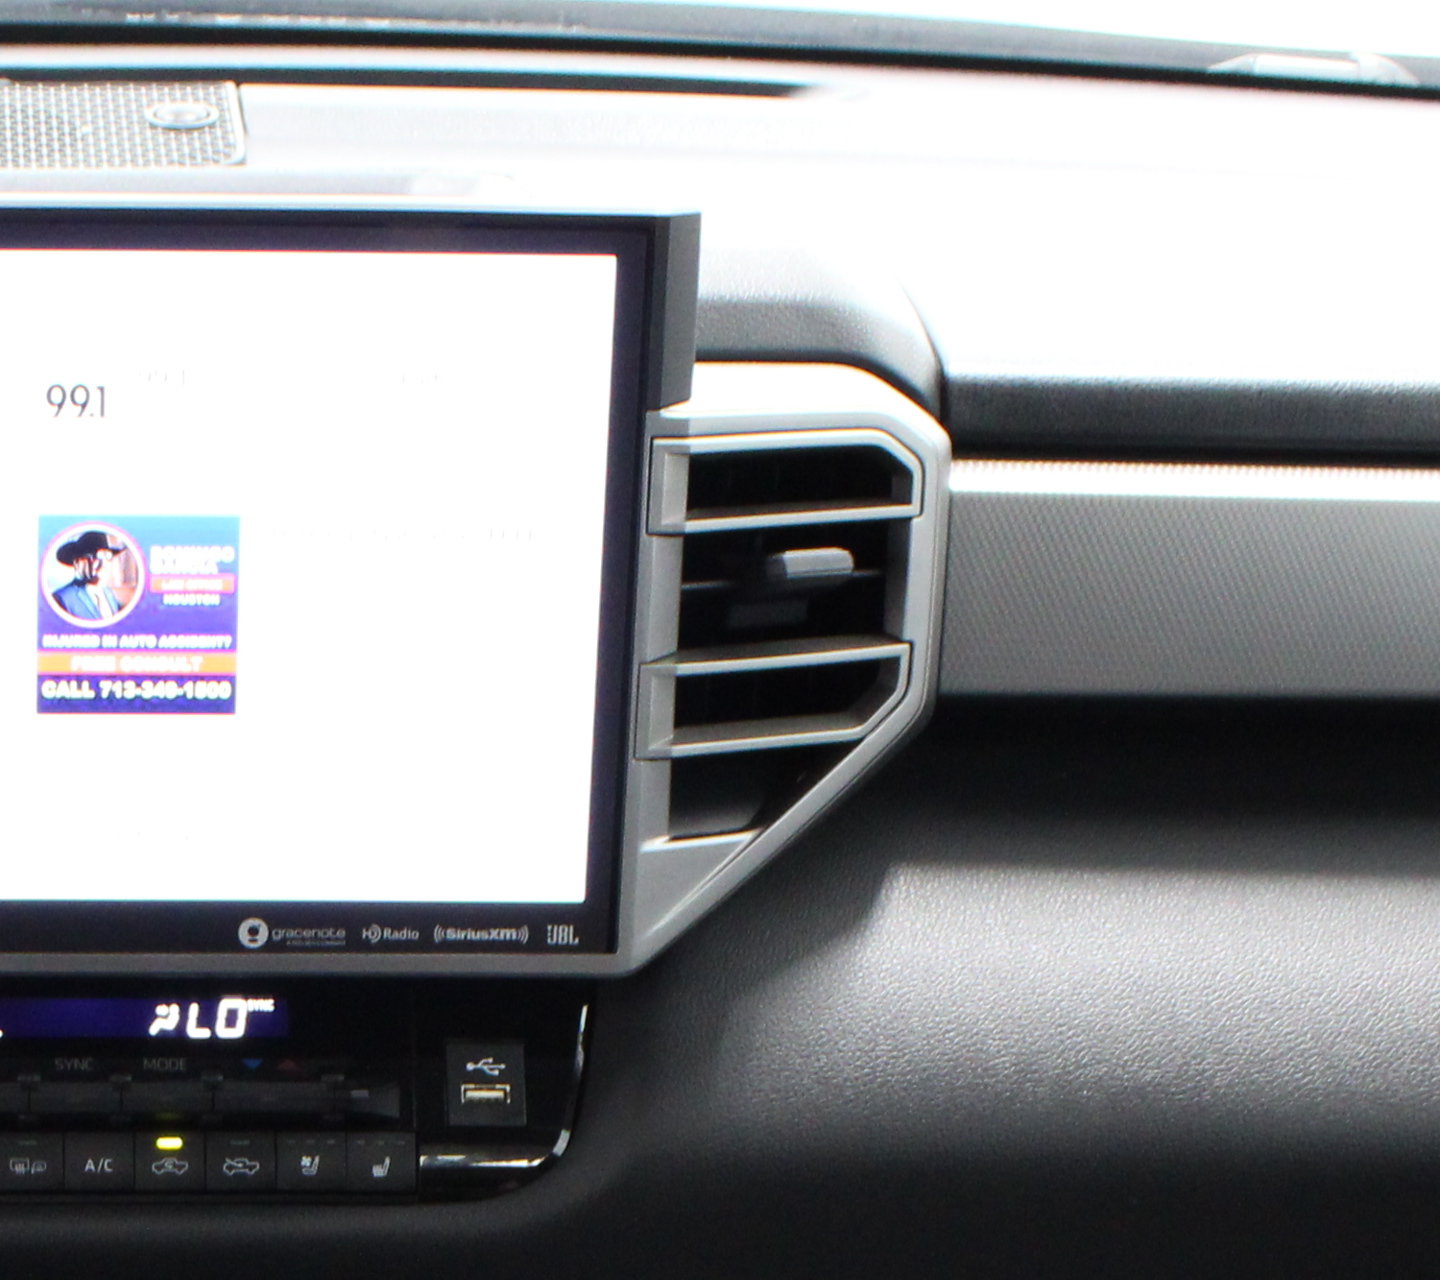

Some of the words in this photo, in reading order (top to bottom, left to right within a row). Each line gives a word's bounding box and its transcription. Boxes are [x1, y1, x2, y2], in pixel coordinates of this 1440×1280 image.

[45, 383, 108, 421] 99.1
[42, 681, 94, 698] CALL
[272, 926, 347, 942] gracenote
[384, 927, 419, 941] Radio
[547, 925, 579, 945] JBL
[186, 997, 247, 1040] LO
[54, 1057, 95, 1073] SYNC
[143, 1057, 188, 1073] MODE
[85, 1158, 113, 1173] A/C
